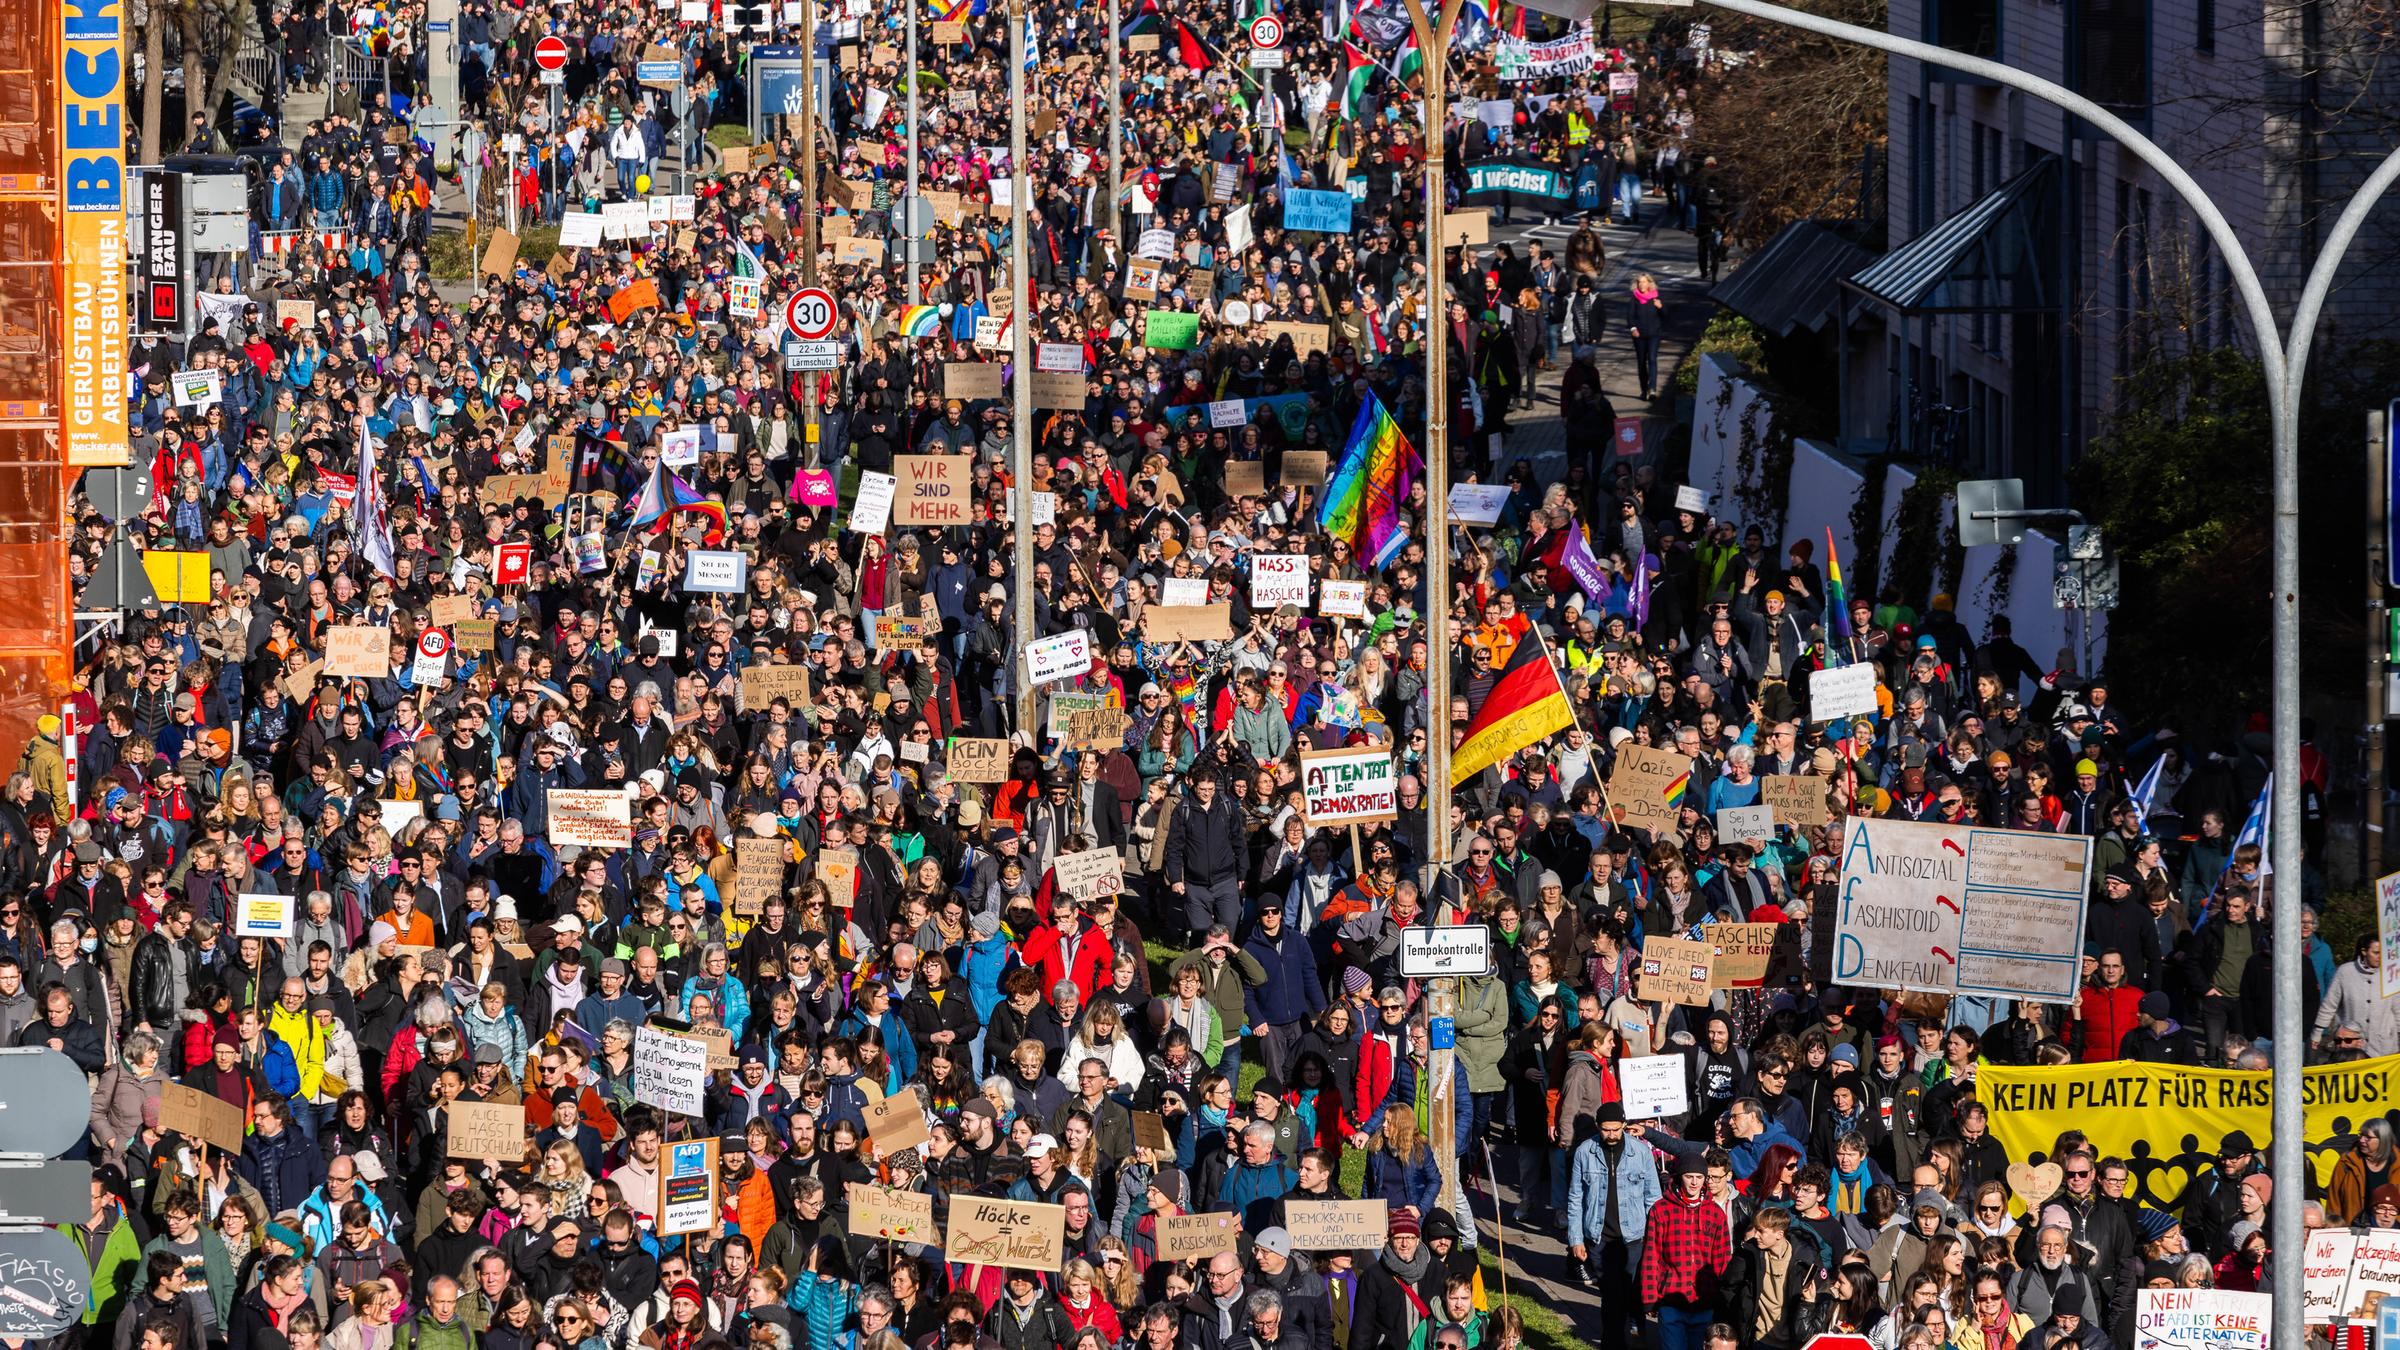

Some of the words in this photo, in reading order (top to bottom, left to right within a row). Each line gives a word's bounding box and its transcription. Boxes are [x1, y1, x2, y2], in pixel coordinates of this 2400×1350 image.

[1257, 26, 1276, 39] 30
[1486, 168, 1547, 193] wächst
[68, 203, 120, 212] www.becker.eu
[151, 183, 164, 277] SÄNGER
[164, 230, 176, 277] BAU
[100, 219, 120, 425] ARBEITSBÜHNEN
[798, 302, 826, 325] 30
[74, 282, 94, 425] GERÜSTBAU
[799, 344, 826, 353] 22-6h
[792, 356, 832, 367] Lärmschutz
[72, 441, 124, 452] becker.eu
[910, 460, 948, 480] WIR
[914, 483, 950, 497] SIND
[910, 501, 961, 520] MEHR
[1259, 558, 1294, 573] HASS
[423, 636, 445, 650] AFD
[746, 672, 772, 684] NAZIS
[776, 670, 802, 681] ESSEN
[1035, 668, 1055, 678] Hass
[1063, 658, 1087, 671] Angst
[952, 740, 998, 760] KEIN
[951, 760, 998, 769] BOCK
[1622, 748, 1675, 777] Nazis
[1308, 759, 1390, 786] ATTENTAT
[1307, 784, 1328, 797] AUF
[1335, 782, 1354, 794] DIE
[1766, 778, 1786, 795] Wer
[1788, 778, 1797, 795] A
[1799, 781, 1816, 800] sagt
[1628, 800, 1680, 820] Döner
[1794, 796, 1816, 809] nicht
[1732, 825, 1767, 840] Mensch
[740, 842, 776, 854] BRAUNE
[1842, 820, 1958, 882] ANTISOZIAL
[1706, 924, 1802, 946] FASCHISMUS
[1406, 944, 1484, 958] Tempokontrolle
[1650, 946, 1676, 960] LOVE
[1678, 948, 1705, 964] WEED
[1726, 946, 1740, 955] IST
[1838, 932, 1946, 986] DENKFAUL
[1663, 962, 1687, 978] AND
[1648, 979, 1673, 994] HATE
[1676, 980, 1705, 998] NAZIS
[638, 1029, 661, 1044] Lieber
[664, 1038, 679, 1052] mit
[680, 1040, 706, 1056] Besen
[636, 1064, 650, 1078] als
[651, 1070, 664, 1081] zu
[668, 1073, 692, 1087] lesen
[1708, 1064, 1732, 1074] GEGEN
[1993, 1082, 2057, 1112] KEIN
[2067, 1077, 2150, 1110] PLATZ
[2158, 1073, 2208, 1108] FÜR
[2218, 1071, 2389, 1108] RASSMUS!
[471, 1109, 500, 1122] ALICE
[468, 1122, 514, 1138] HASST
[450, 1136, 525, 1156] DEUTSCHLAND
[678, 1146, 701, 1157] AfD
[854, 1190, 882, 1206] NIE
[888, 1196, 932, 1214] WIEDER
[669, 1208, 708, 1220] AFD-Verbot
[880, 1214, 928, 1229] RECHTS
[974, 1204, 1032, 1226] Höcke
[1168, 1216, 1194, 1230] NEIN
[1196, 1216, 1210, 1229] ZU
[1290, 1212, 1364, 1226] DEMOKRATIE
[679, 1220, 698, 1228] jetzt!
[1322, 1225, 1344, 1234] UND
[951, 1230, 1006, 1264] Curry
[1006, 1236, 1052, 1263] Wurst
[1170, 1234, 1227, 1252] RASSISMUS
[1290, 1232, 1382, 1249] MENSCHENRECHTE
[2316, 1240, 2335, 1258] Wir
[2304, 1267, 2321, 1279] nur
[2321, 1264, 2346, 1278] einen
[2150, 1292, 2194, 1311] NEIN
[2304, 1284, 2340, 1308] Bernd!
[2140, 1312, 2166, 1330] DIE
[2193, 1314, 2211, 1326] IST
[2214, 1314, 2258, 1330] KEINE
